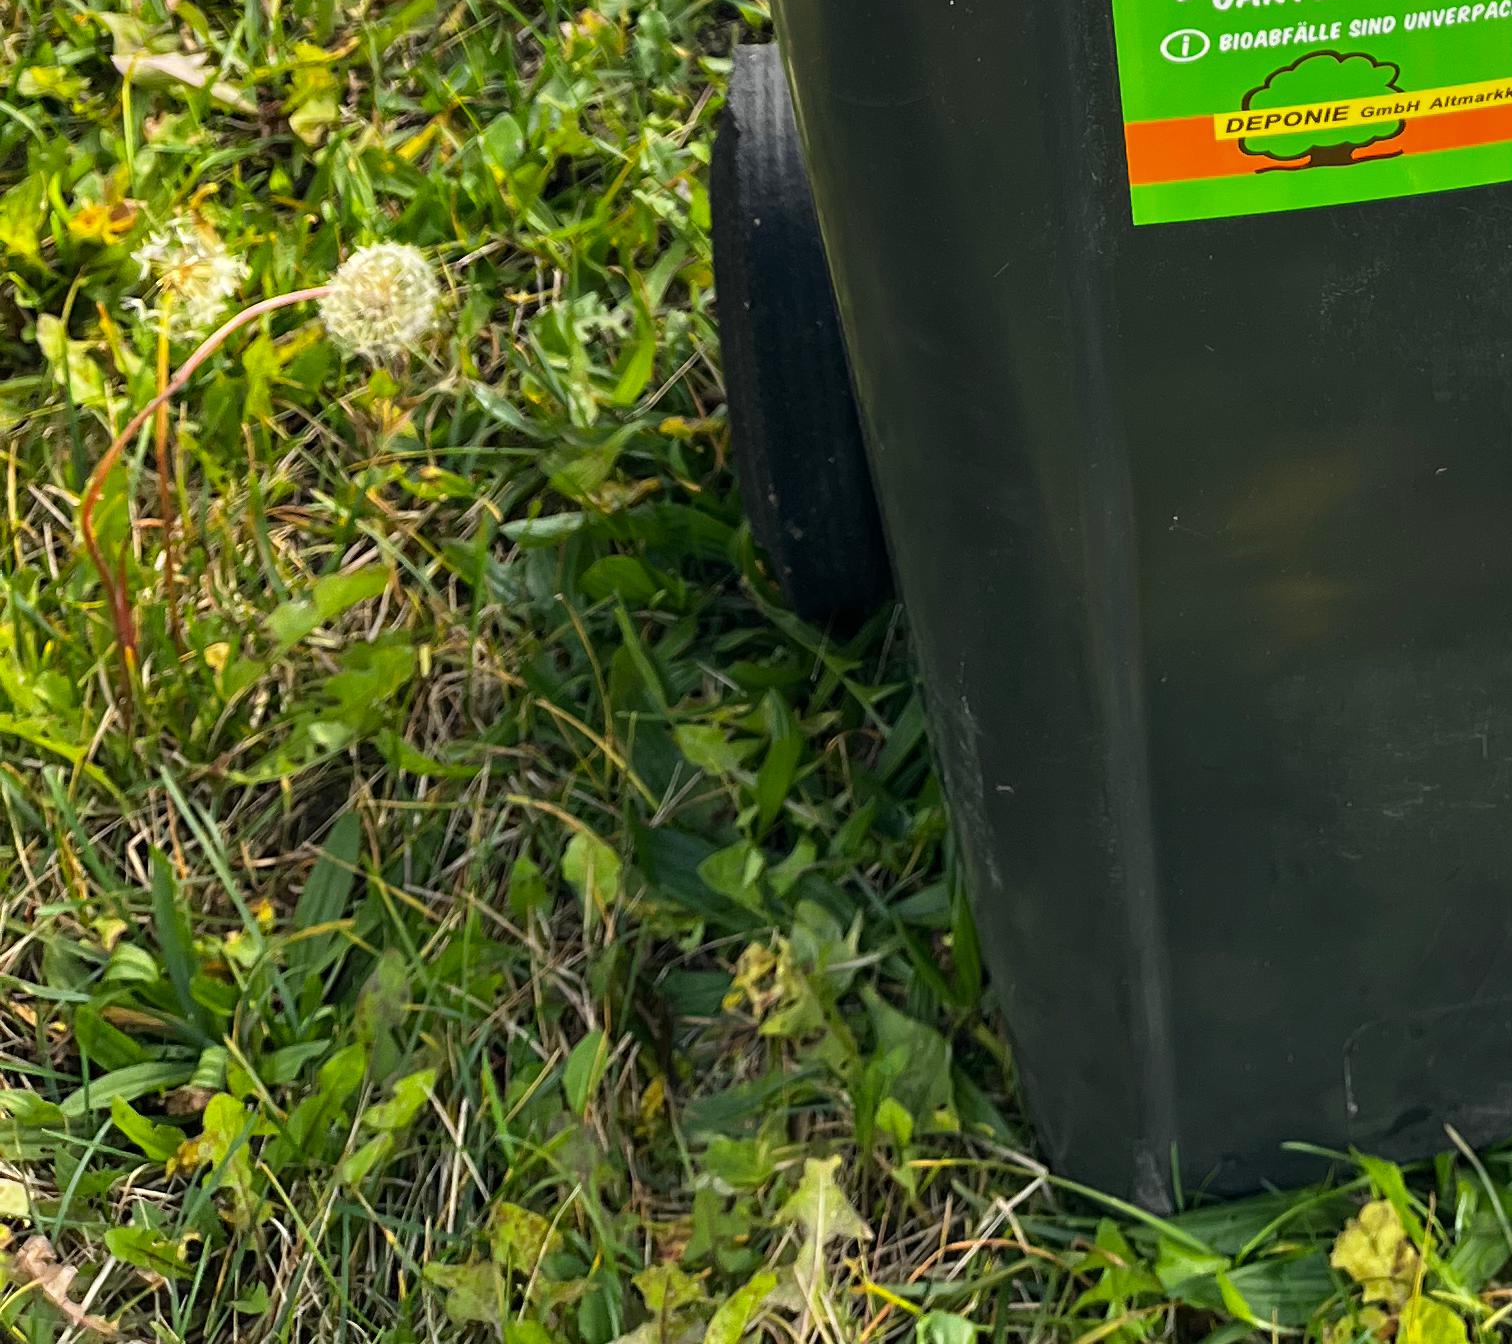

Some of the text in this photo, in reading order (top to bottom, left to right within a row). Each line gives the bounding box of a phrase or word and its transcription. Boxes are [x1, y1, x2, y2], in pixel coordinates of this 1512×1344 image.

[1220, 22, 1341, 51] BIOABFÄLLE
[1349, 16, 1396, 37] SIND
[1226, 105, 1350, 133] DEPONIE
[1360, 100, 1420, 118] GmbH
